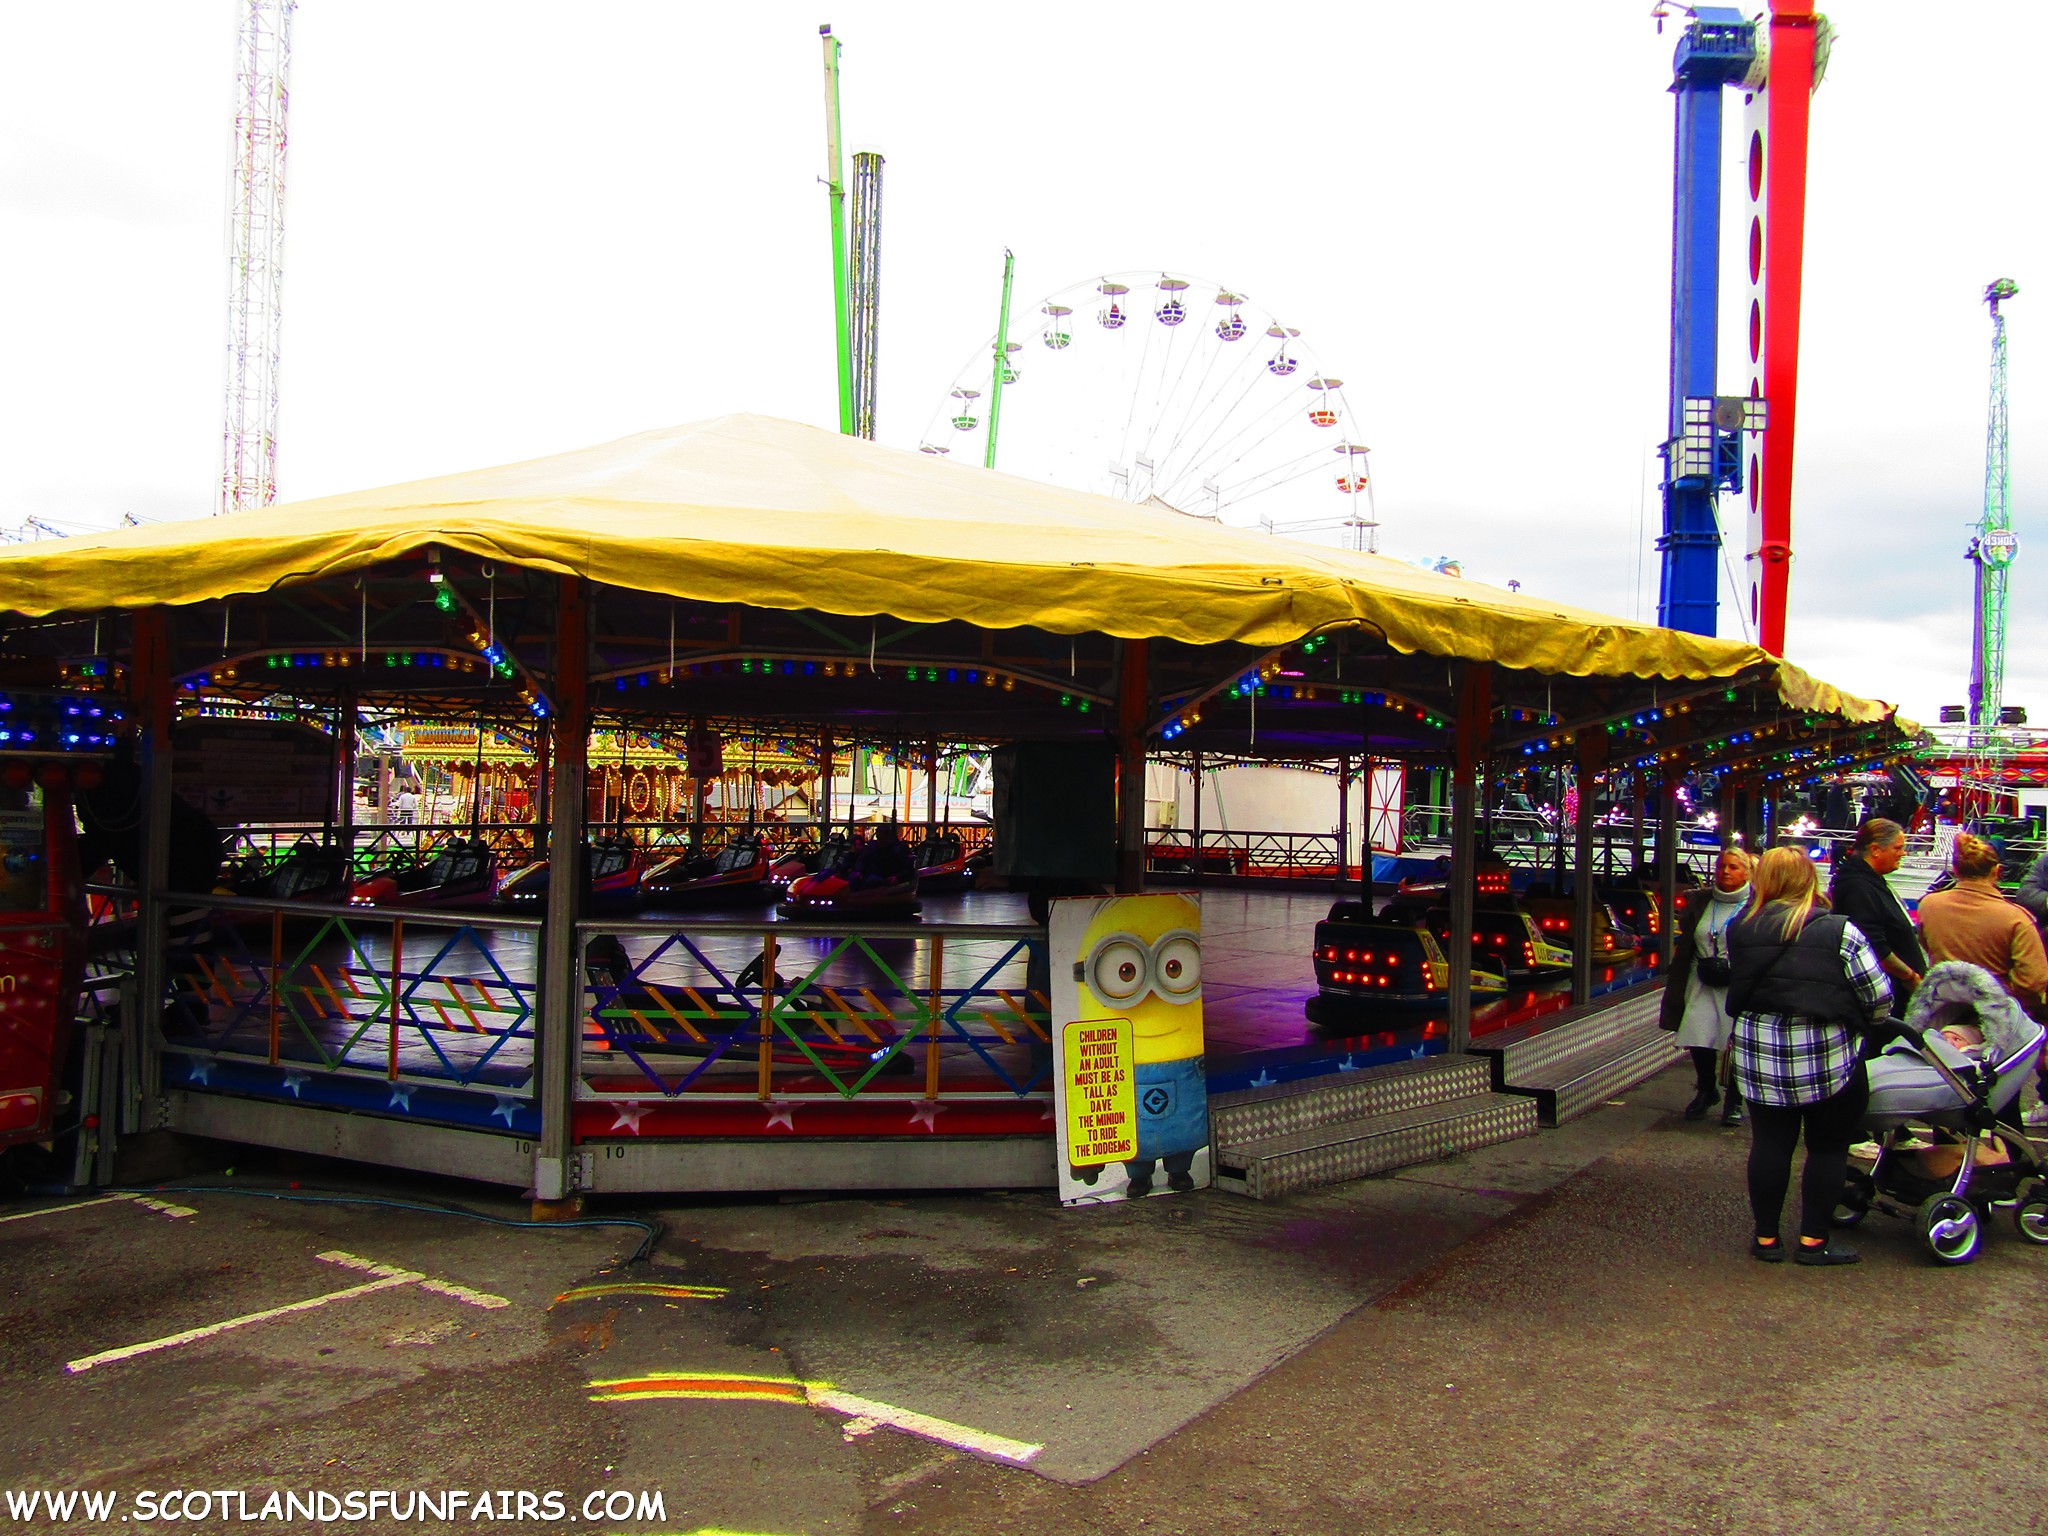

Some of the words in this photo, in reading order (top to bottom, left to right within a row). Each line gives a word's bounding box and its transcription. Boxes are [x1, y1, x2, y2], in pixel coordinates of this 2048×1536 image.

[1984, 534, 2016, 546] JOKER
[1079, 1028, 1117, 1043] CHILDREN
[1080, 1042, 1117, 1057] WITHOUT
[1079, 1059, 1091, 1071] AN
[1094, 1056, 1119, 1070] ADULT
[1075, 1071, 1098, 1086] MUST
[1101, 1070, 1112, 1083] BE
[1114, 1069, 1125, 1082] AS
[1083, 1085, 1104, 1099] TALL
[1107, 1084, 1118, 1097] AS
[1090, 1099, 1112, 1113] DAVE
[1078, 1115, 1094, 1129] THE
[1096, 1112, 1125, 1127] MINION
[1087, 1129, 1098, 1142] TO
[1100, 1127, 1118, 1141] RIDE
[515, 1140, 530, 1154] 10
[605, 1146, 625, 1159] 10
[1075, 1145, 1090, 1158] THE
[1093, 1139, 1131, 1156] DODGEMS
